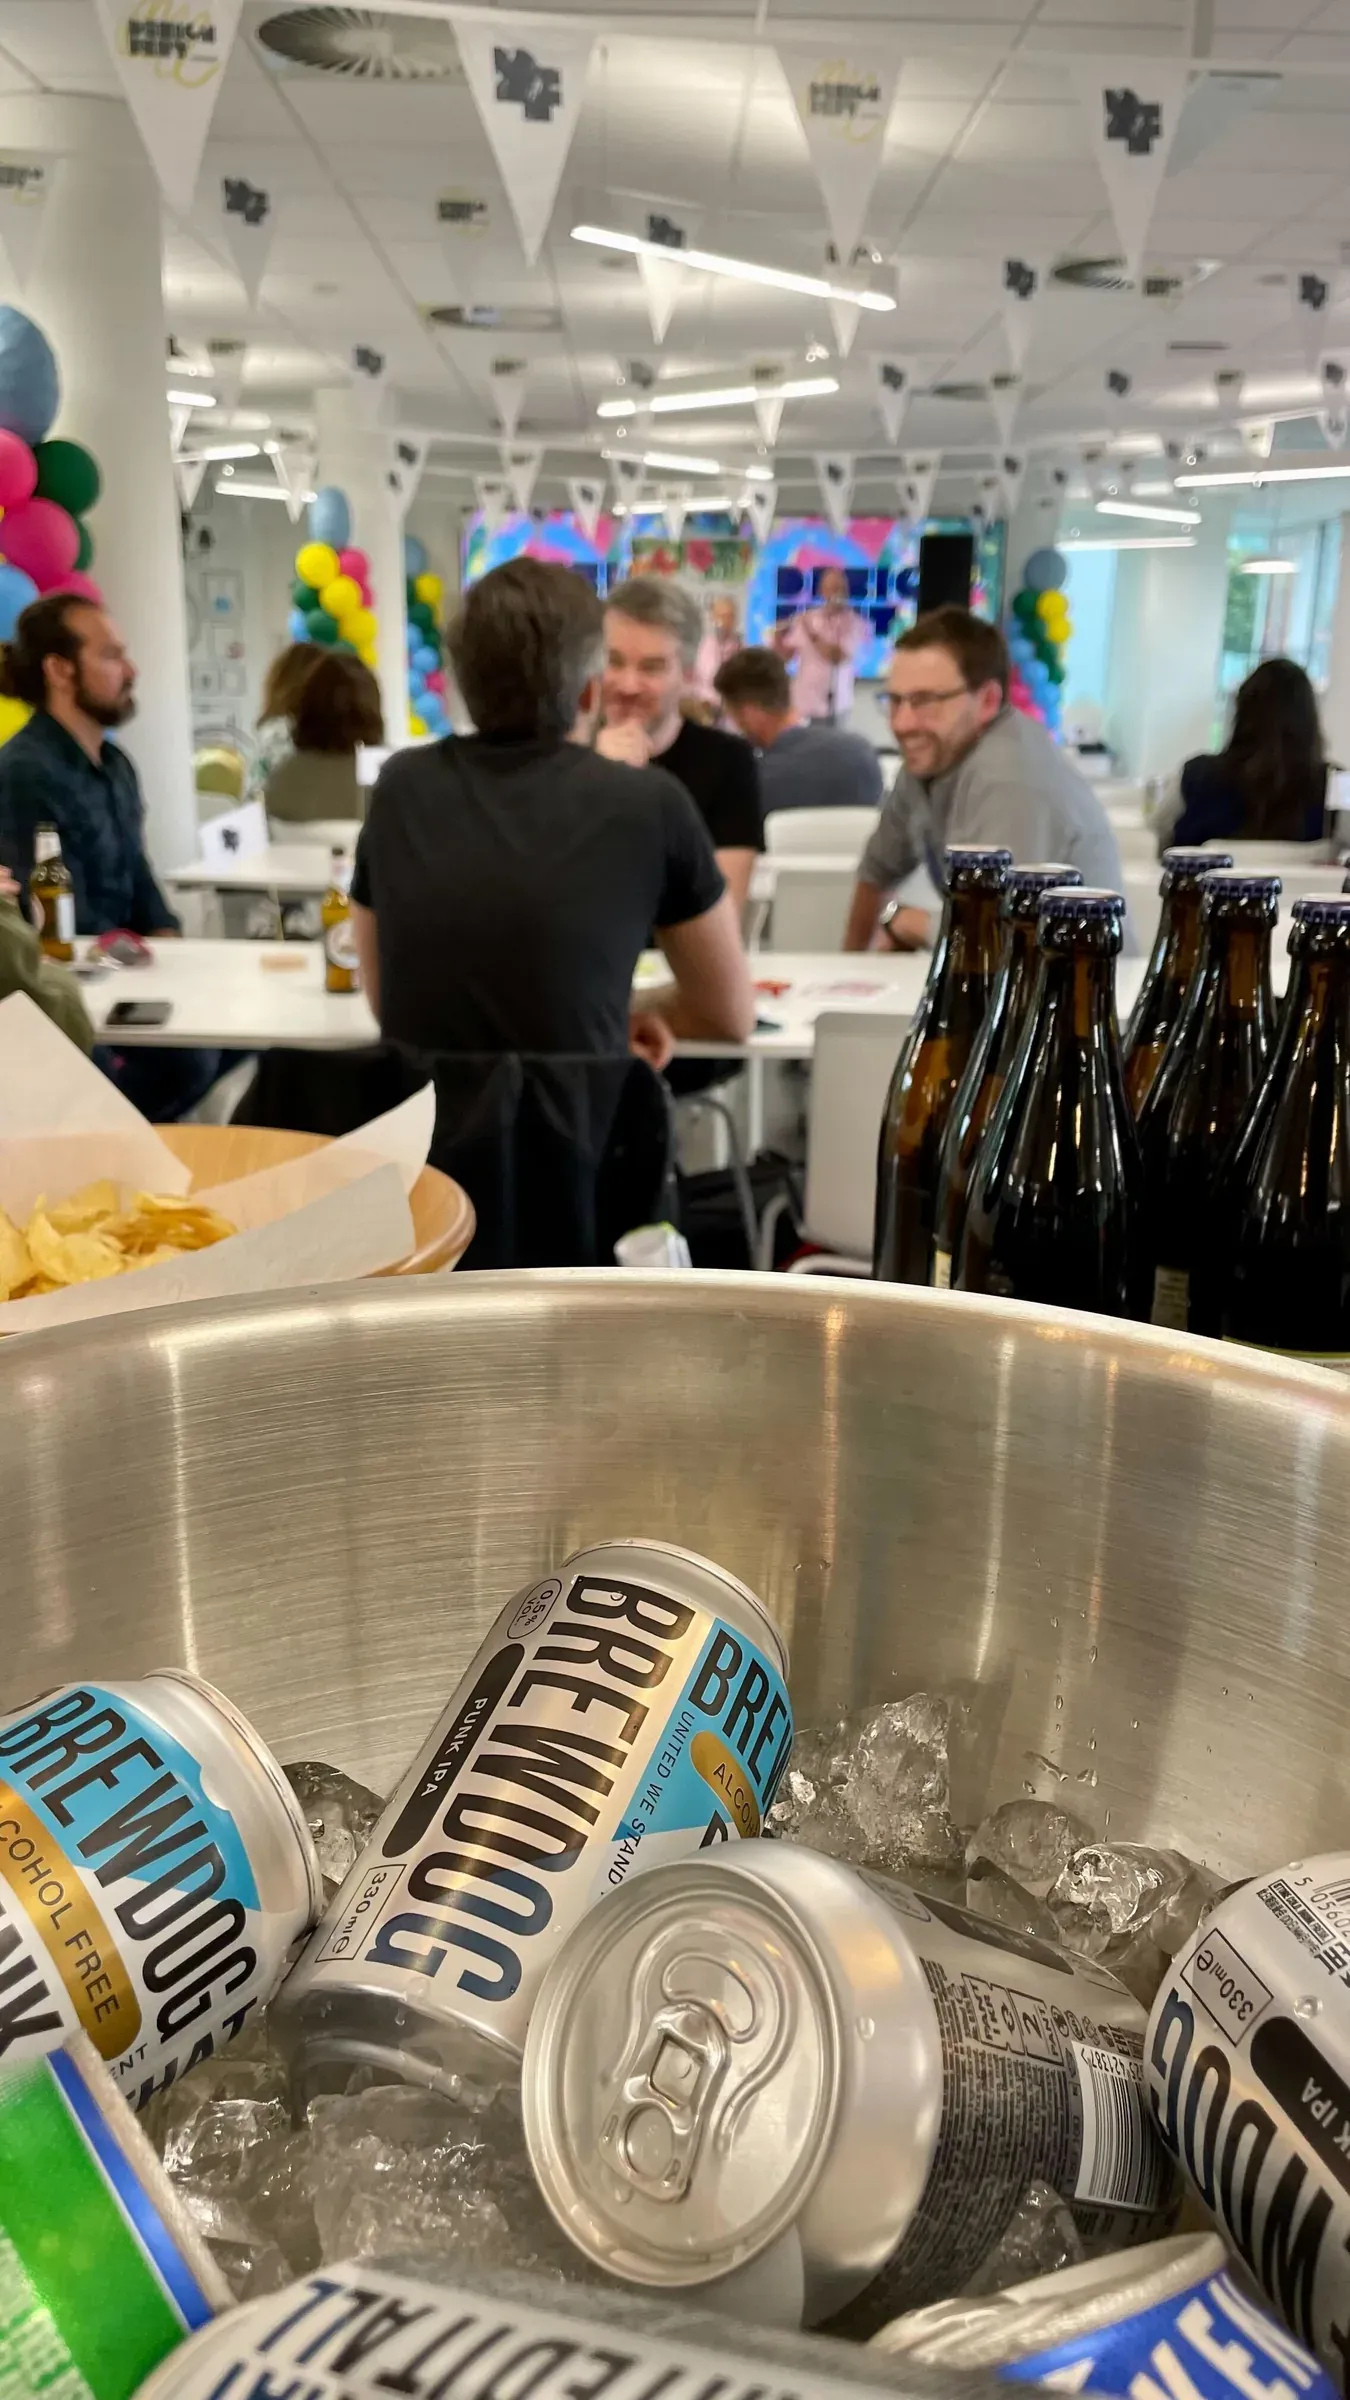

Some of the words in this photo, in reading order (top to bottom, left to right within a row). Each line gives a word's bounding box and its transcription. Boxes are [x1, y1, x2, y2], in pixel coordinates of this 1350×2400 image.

[525, 1590, 553, 1626] 0.5%
[444, 1697, 488, 1755] PUNK
[657, 1711, 695, 1779] UNITED
[364, 1575, 696, 2001] BREWDOG
[421, 1761, 452, 1797] IPA
[639, 1784, 663, 1815] WE
[0, 1690, 258, 2043] BREWDOG
[608, 1817, 646, 1886] STAND
[0, 1820, 73, 1930] COHOL
[65, 1929, 120, 2023] FREE
[1301, 2077, 1340, 2128] IPA
